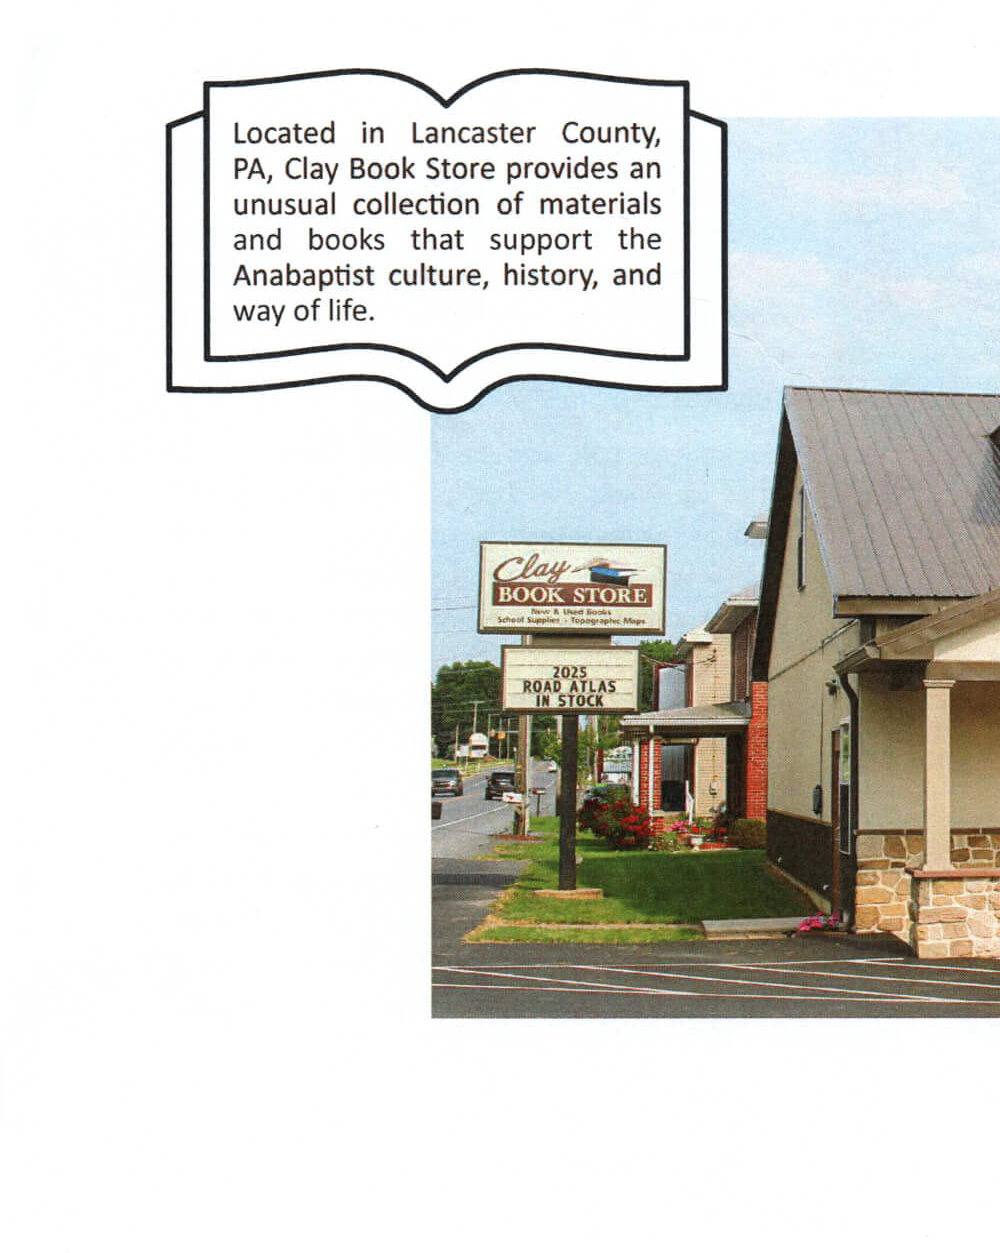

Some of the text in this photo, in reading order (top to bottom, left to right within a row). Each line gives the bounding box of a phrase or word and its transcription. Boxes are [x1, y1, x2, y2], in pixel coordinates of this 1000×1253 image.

[234, 120, 661, 150] Located in Lancaster County,
[234, 155, 661, 185] PA, Clay Book Store provides an
[234, 190, 662, 216] unusual collection of materials
[233, 226, 662, 256] and books that support the
[232, 262, 661, 292] Anabaptist culture, history, and
[232, 297, 375, 327] way of life.
[493, 553, 571, 584] Clay
[498, 586, 648, 604] BOOK STORE
[497, 615, 524, 624] School
[571, 617, 620, 626] Topographic
[623, 618, 646, 626] Maps
[553, 665, 587, 679] 2025
[523, 680, 616, 693] ROAD ATLAS
[536, 694, 604, 708] IN STOCK
